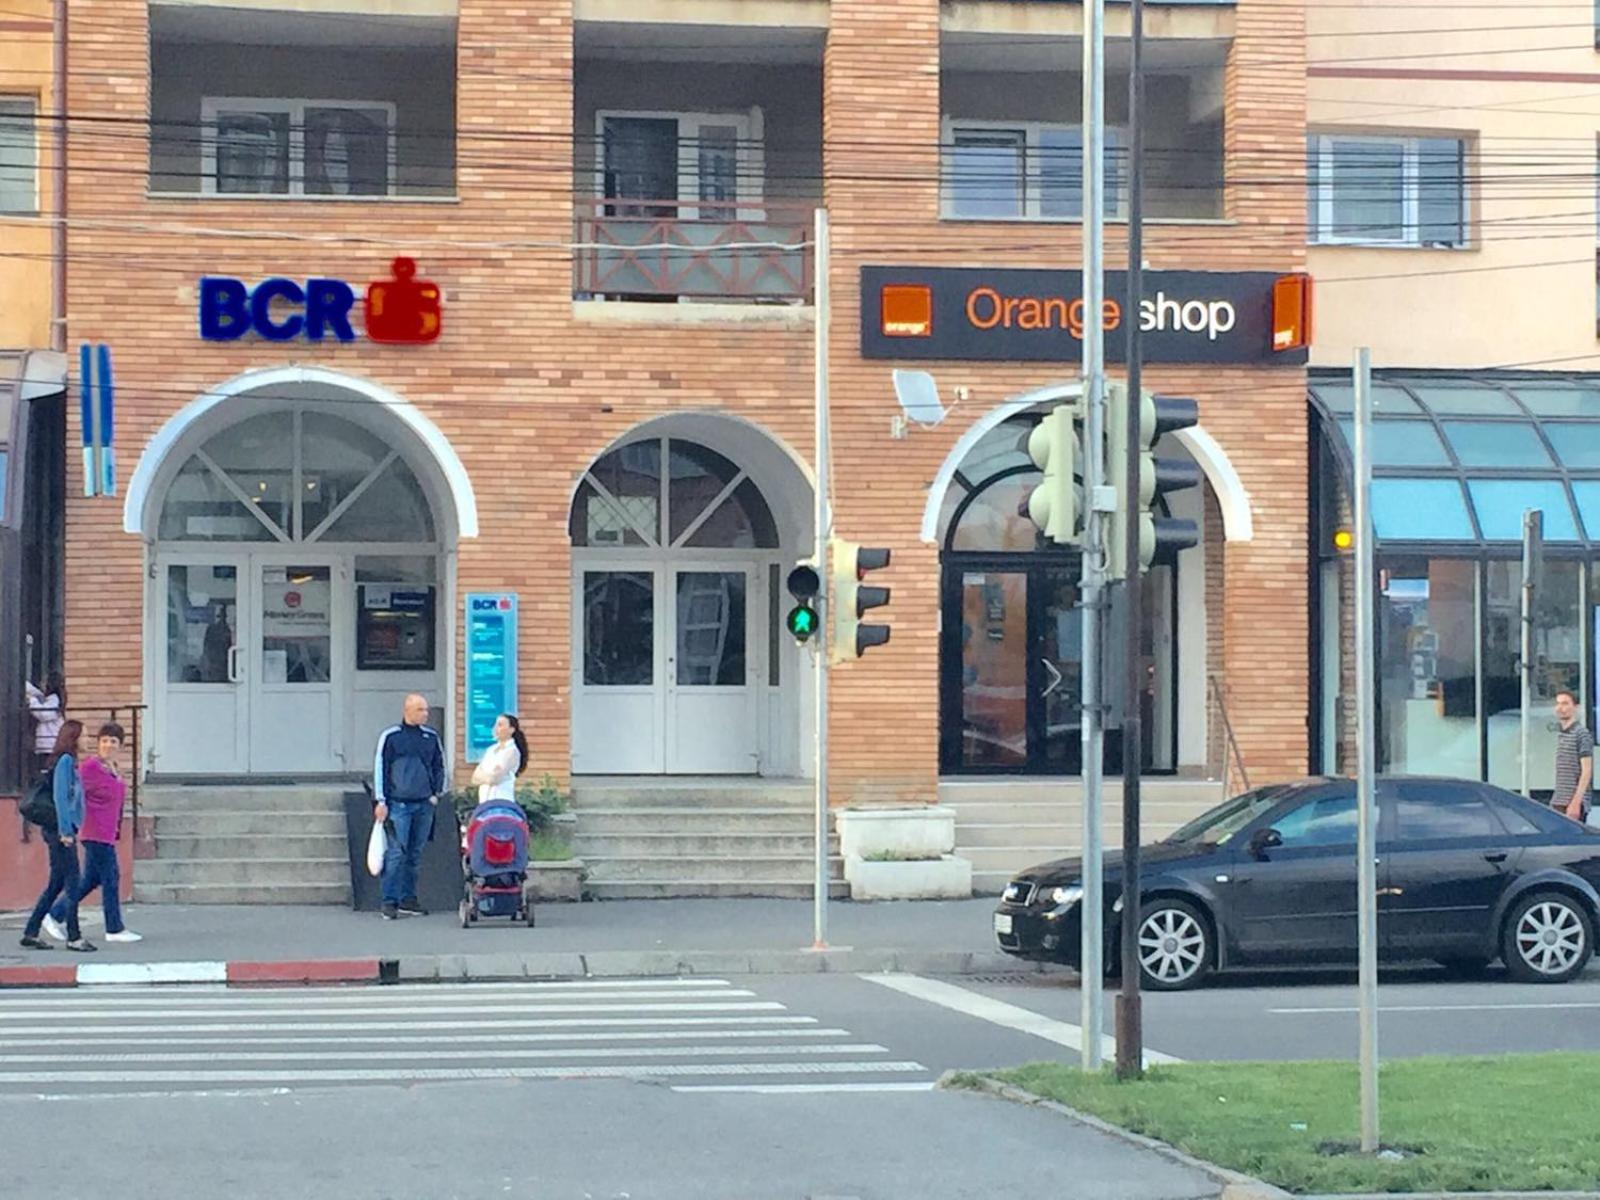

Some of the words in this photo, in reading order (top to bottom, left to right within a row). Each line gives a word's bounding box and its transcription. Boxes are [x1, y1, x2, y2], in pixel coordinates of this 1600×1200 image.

[199, 277, 355, 342] BCR
[1139, 291, 1236, 340] shop
[472, 599, 498, 611] BCR
